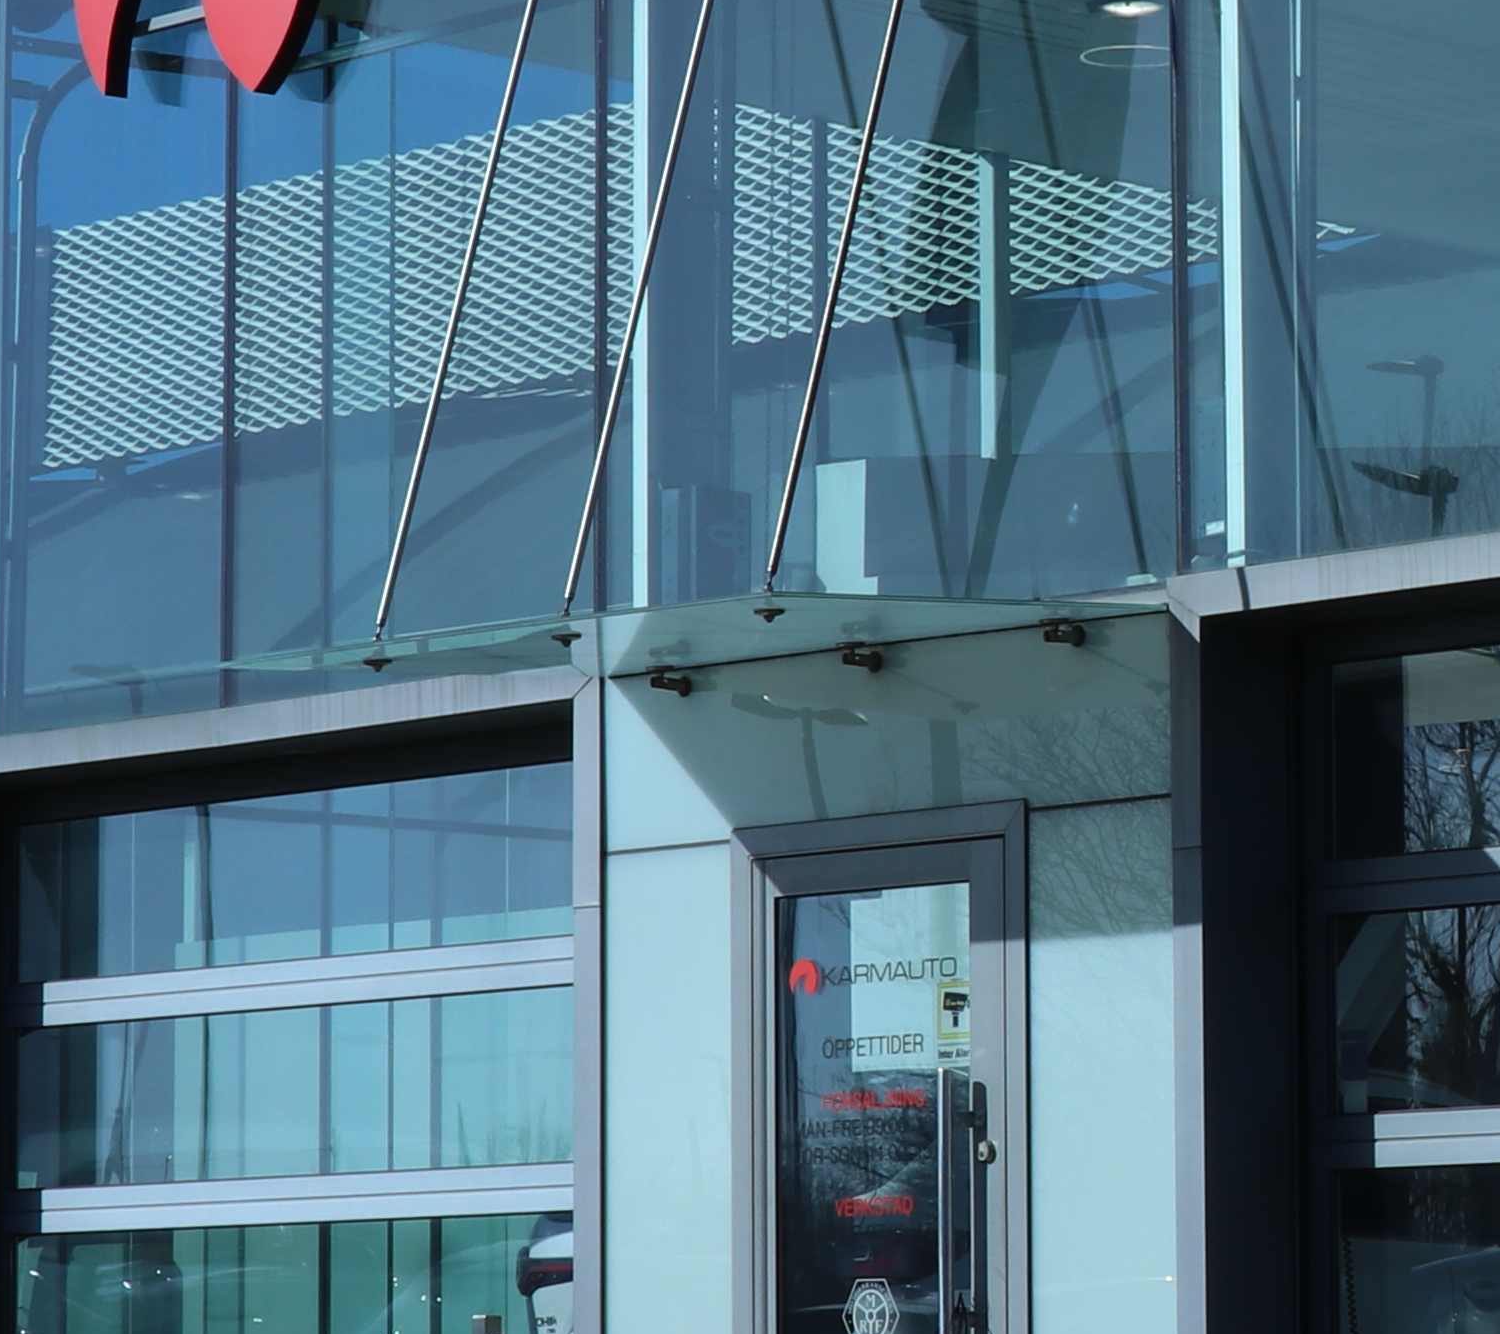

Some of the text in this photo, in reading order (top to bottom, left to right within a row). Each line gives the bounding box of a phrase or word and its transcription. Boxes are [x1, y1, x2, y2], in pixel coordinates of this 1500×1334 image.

[820, 956, 958, 987] KARMAUTO
[821, 1032, 924, 1059] ÖPPETTIDER
[834, 1194, 917, 1218] VERKSTAD
